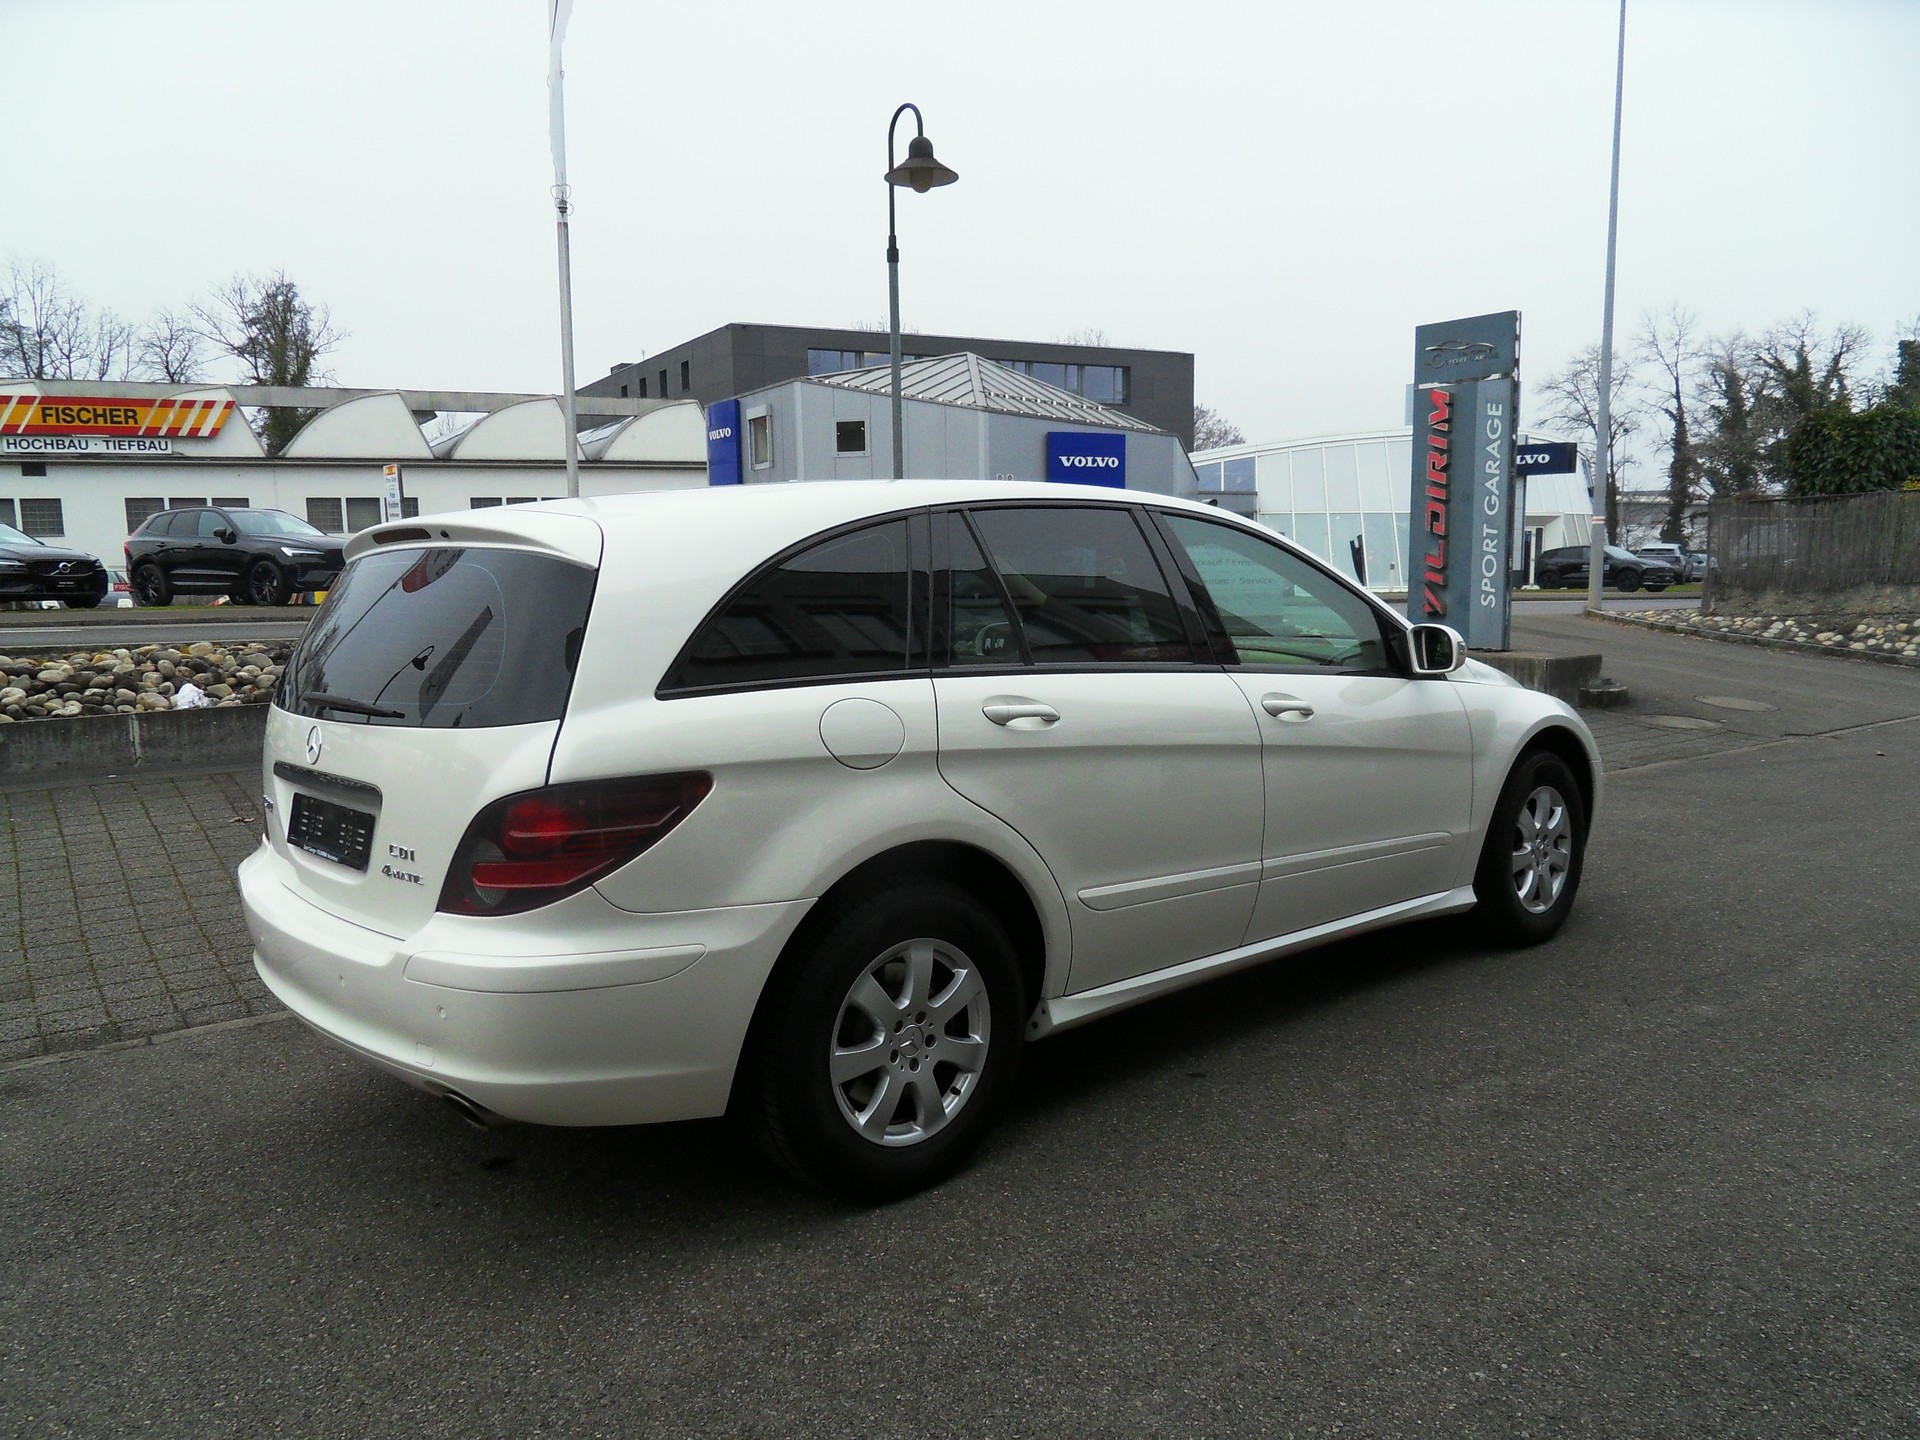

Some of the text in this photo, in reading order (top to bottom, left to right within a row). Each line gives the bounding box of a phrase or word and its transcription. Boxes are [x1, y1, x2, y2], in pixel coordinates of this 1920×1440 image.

[41, 406, 139, 425] FISCHER
[709, 427, 732, 441] VOLVO
[6, 438, 90, 451] HOCHBAU
[102, 439, 169, 452] TIEFBAU
[1058, 455, 1120, 468] VOLVO
[1516, 453, 1550, 465] LVO
[1422, 388, 1452, 616] YILDIRIM
[1480, 402, 1503, 608] SPORT GARAGE
[389, 843, 416, 863] CDI
